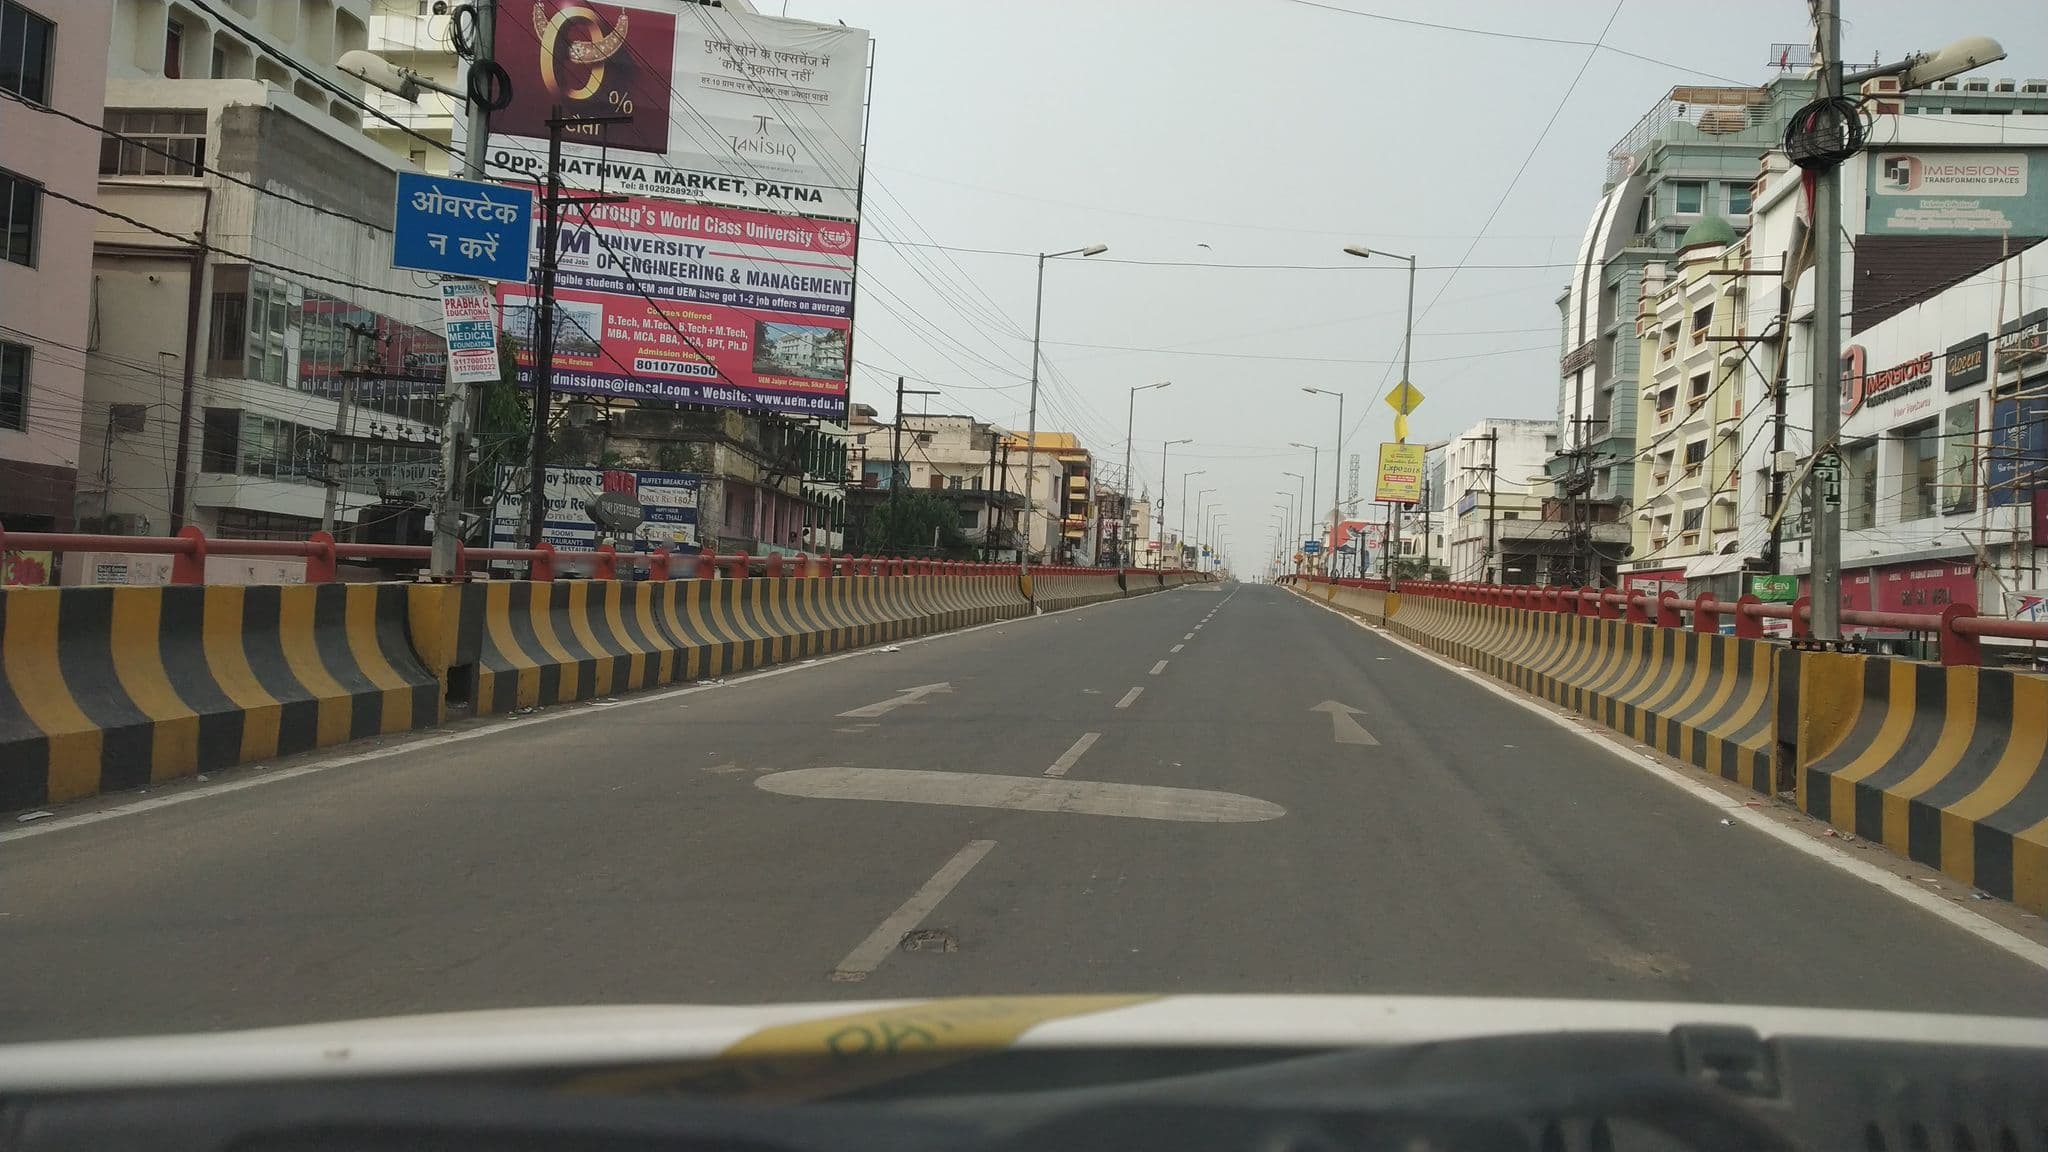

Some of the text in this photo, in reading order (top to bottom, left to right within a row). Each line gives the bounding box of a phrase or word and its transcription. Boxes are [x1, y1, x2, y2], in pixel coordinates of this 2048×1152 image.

[760, 46, 771, 60] के
[821, 54, 830, 68] में
[701, 76, 711, 84] हर
[728, 136, 797, 163] TANISHQ
[494, 151, 823, 204] Opp. HATHWA MARKET, PATNA
[1988, 177, 2020, 185] SPACES
[621, 181, 636, 192] Tel:
[411, 185, 520, 226] ओवरटेक
[590, 201, 656, 229] Group's
[660, 210, 700, 232] World
[705, 215, 741, 236] Class
[746, 221, 813, 249] University
[427, 232, 500, 262] न करें
[598, 233, 706, 260] UNIVERSITY
[596, 252, 851, 299] OF ENGINEERING & MANAGEMENT
[555, 273, 583, 286] ligible
[586, 277, 624, 292] students
[657, 286, 675, 296] and
[676, 287, 697, 297] UEM
[699, 288, 720, 300] have
[722, 292, 737, 305] got
[739, 294, 754, 305] 1-2
[756, 296, 769, 308] job
[771, 299, 798, 310] offers
[799, 302, 810, 310] on
[811, 303, 846, 315] average
[445, 296, 489, 310] PRABHA G
[447, 308, 490, 317] EDUCATIONAL
[682, 309, 713, 321] Offered
[447, 322, 461, 333] IIT
[472, 321, 492, 332] JEE
[608, 314, 640, 329] B.Tech,
[449, 331, 493, 342] MEDICAL
[607, 328, 631, 342] MBA,
[633, 330, 657, 345] MCA,
[659, 333, 680, 347] BBA,
[706, 338, 725, 351] BPT,
[727, 341, 748, 353] Ph.D
[453, 340, 491, 349] FOUNDATION
[638, 347, 716, 362] Admission Helpne
[636, 360, 716, 377] 8010700500
[703, 386, 751, 403] Website:
[755, 394, 845, 412] www.uem.edu.in
[1383, 463, 1403, 474] Expo
[563, 472, 592, 487] Shree
